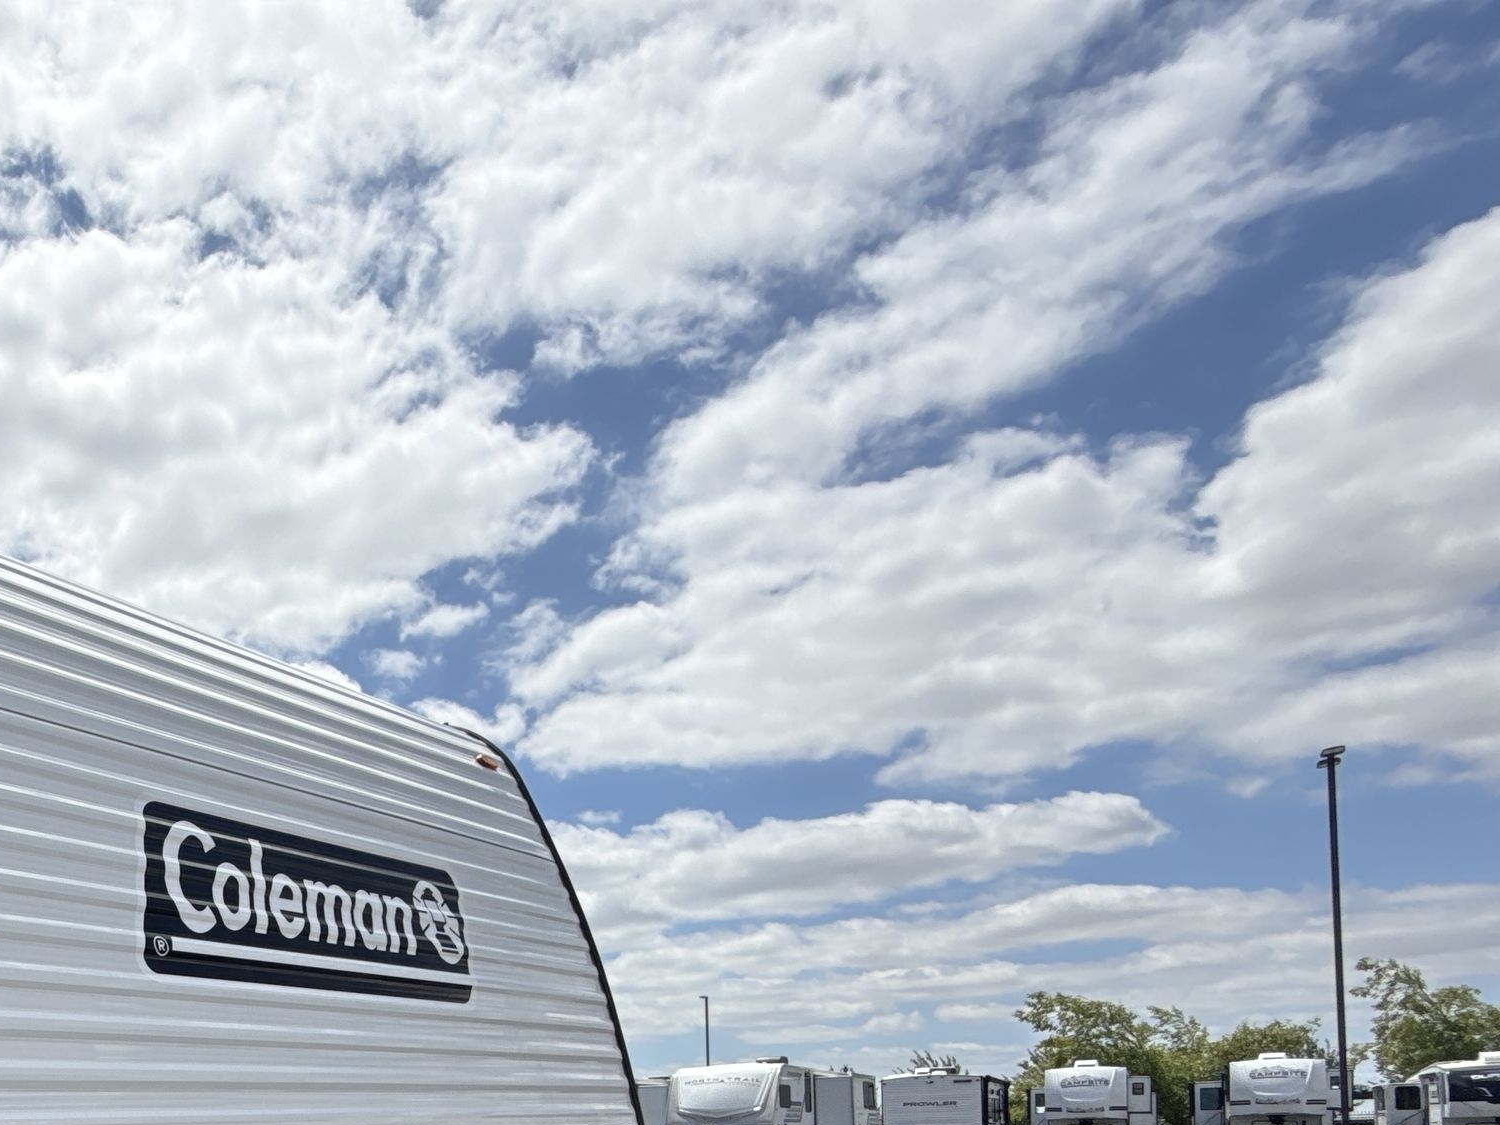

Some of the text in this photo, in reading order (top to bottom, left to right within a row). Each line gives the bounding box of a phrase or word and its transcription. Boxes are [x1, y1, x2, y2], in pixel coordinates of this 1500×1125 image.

[162, 820, 418, 956] Coleman
[1248, 1070, 1308, 1079] CAMPSITE
[1061, 1079, 1110, 1087] CAMPSITE
